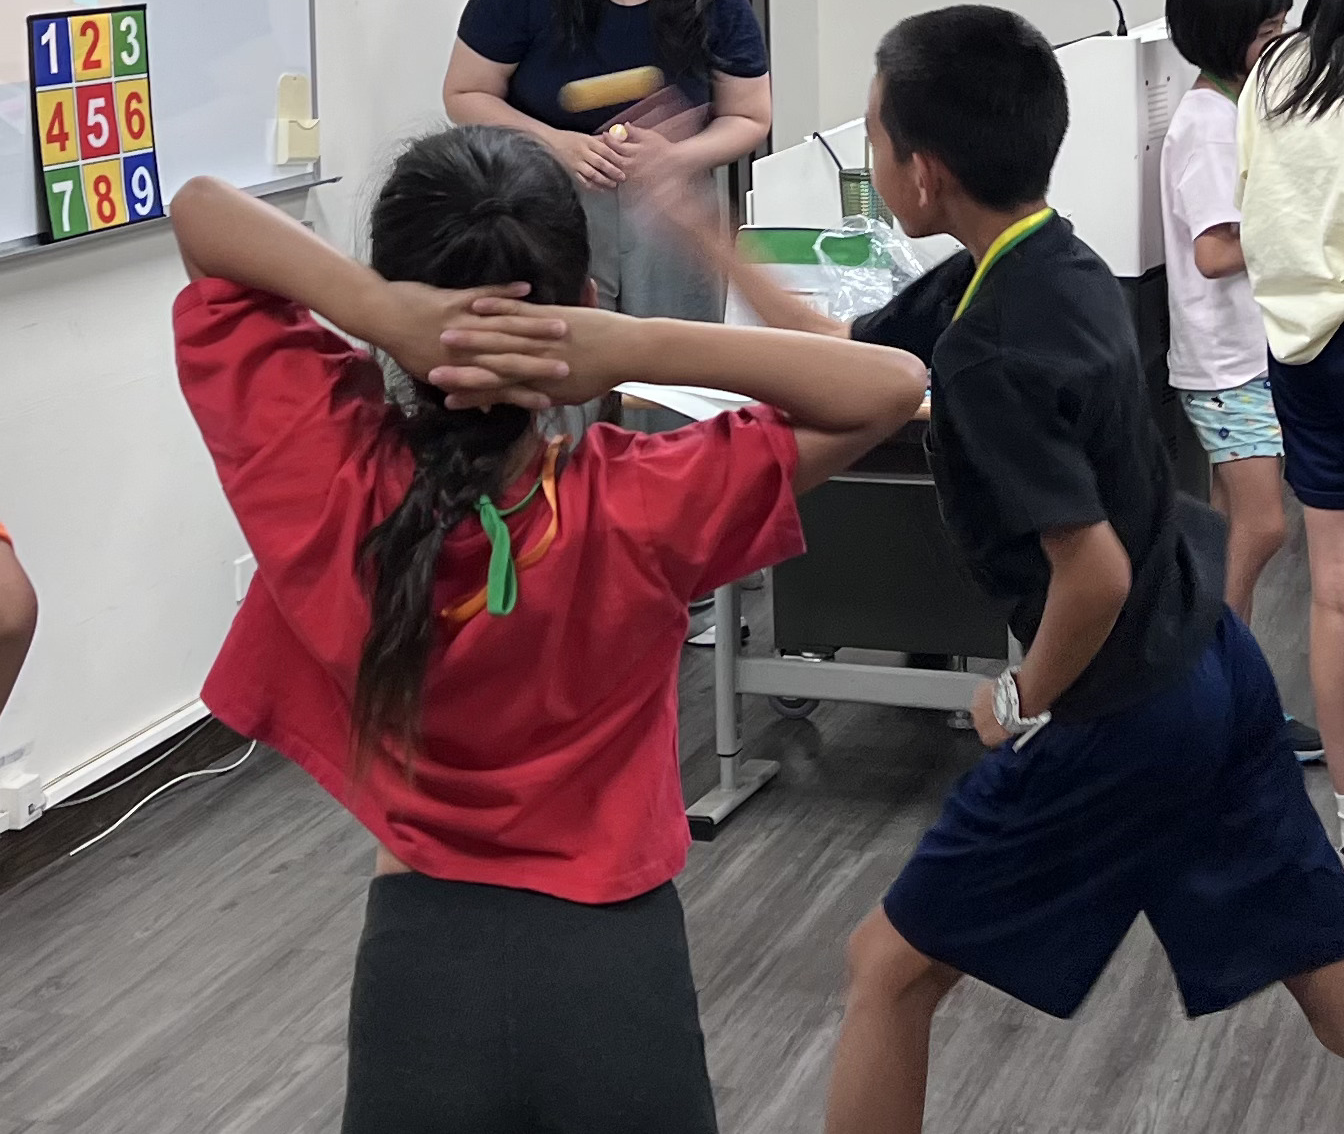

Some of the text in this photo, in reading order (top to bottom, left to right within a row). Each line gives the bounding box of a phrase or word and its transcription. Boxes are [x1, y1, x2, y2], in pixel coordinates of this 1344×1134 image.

[40, 16, 140, 75] 1 2 3
[46, 91, 146, 152] 4 5 6
[51, 166, 154, 233] 7 8 9
